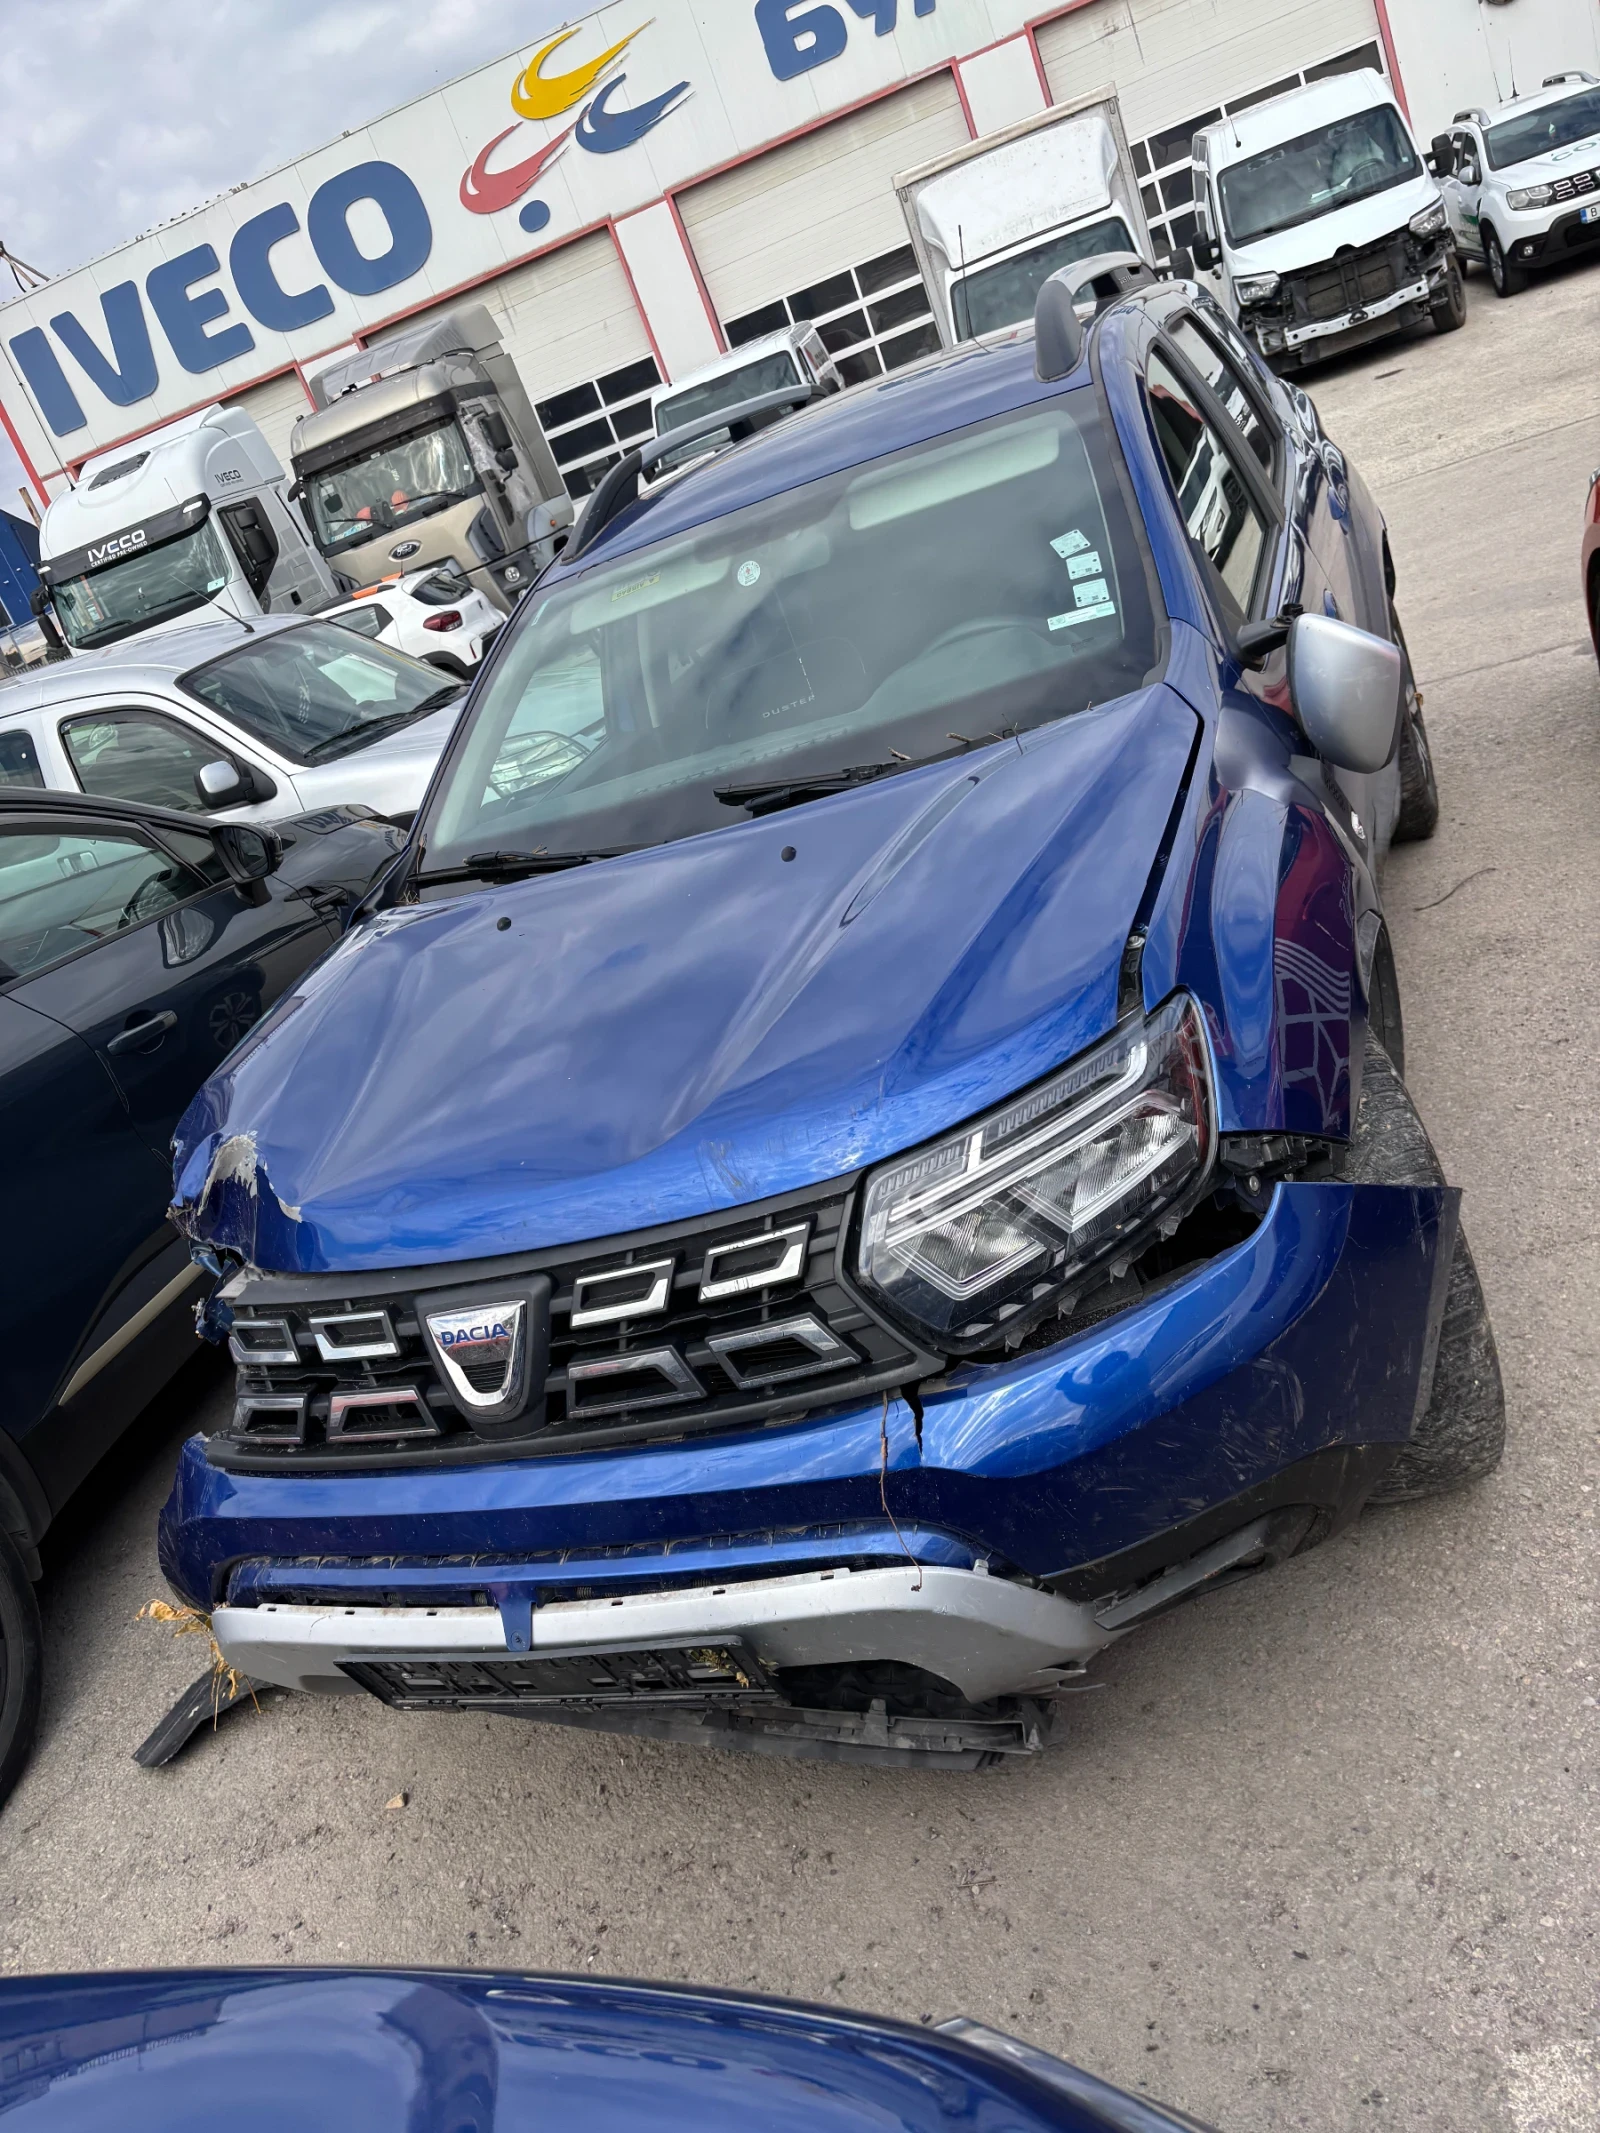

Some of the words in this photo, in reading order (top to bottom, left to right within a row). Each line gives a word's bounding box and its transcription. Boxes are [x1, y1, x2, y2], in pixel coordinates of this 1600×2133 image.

[9, 160, 432, 437] IVECO
[214, 469, 242, 484] IVECO
[87, 529, 146, 562] IVECO
[762, 695, 815, 718] DUSTER
[441, 1323, 509, 1345] DACIA
